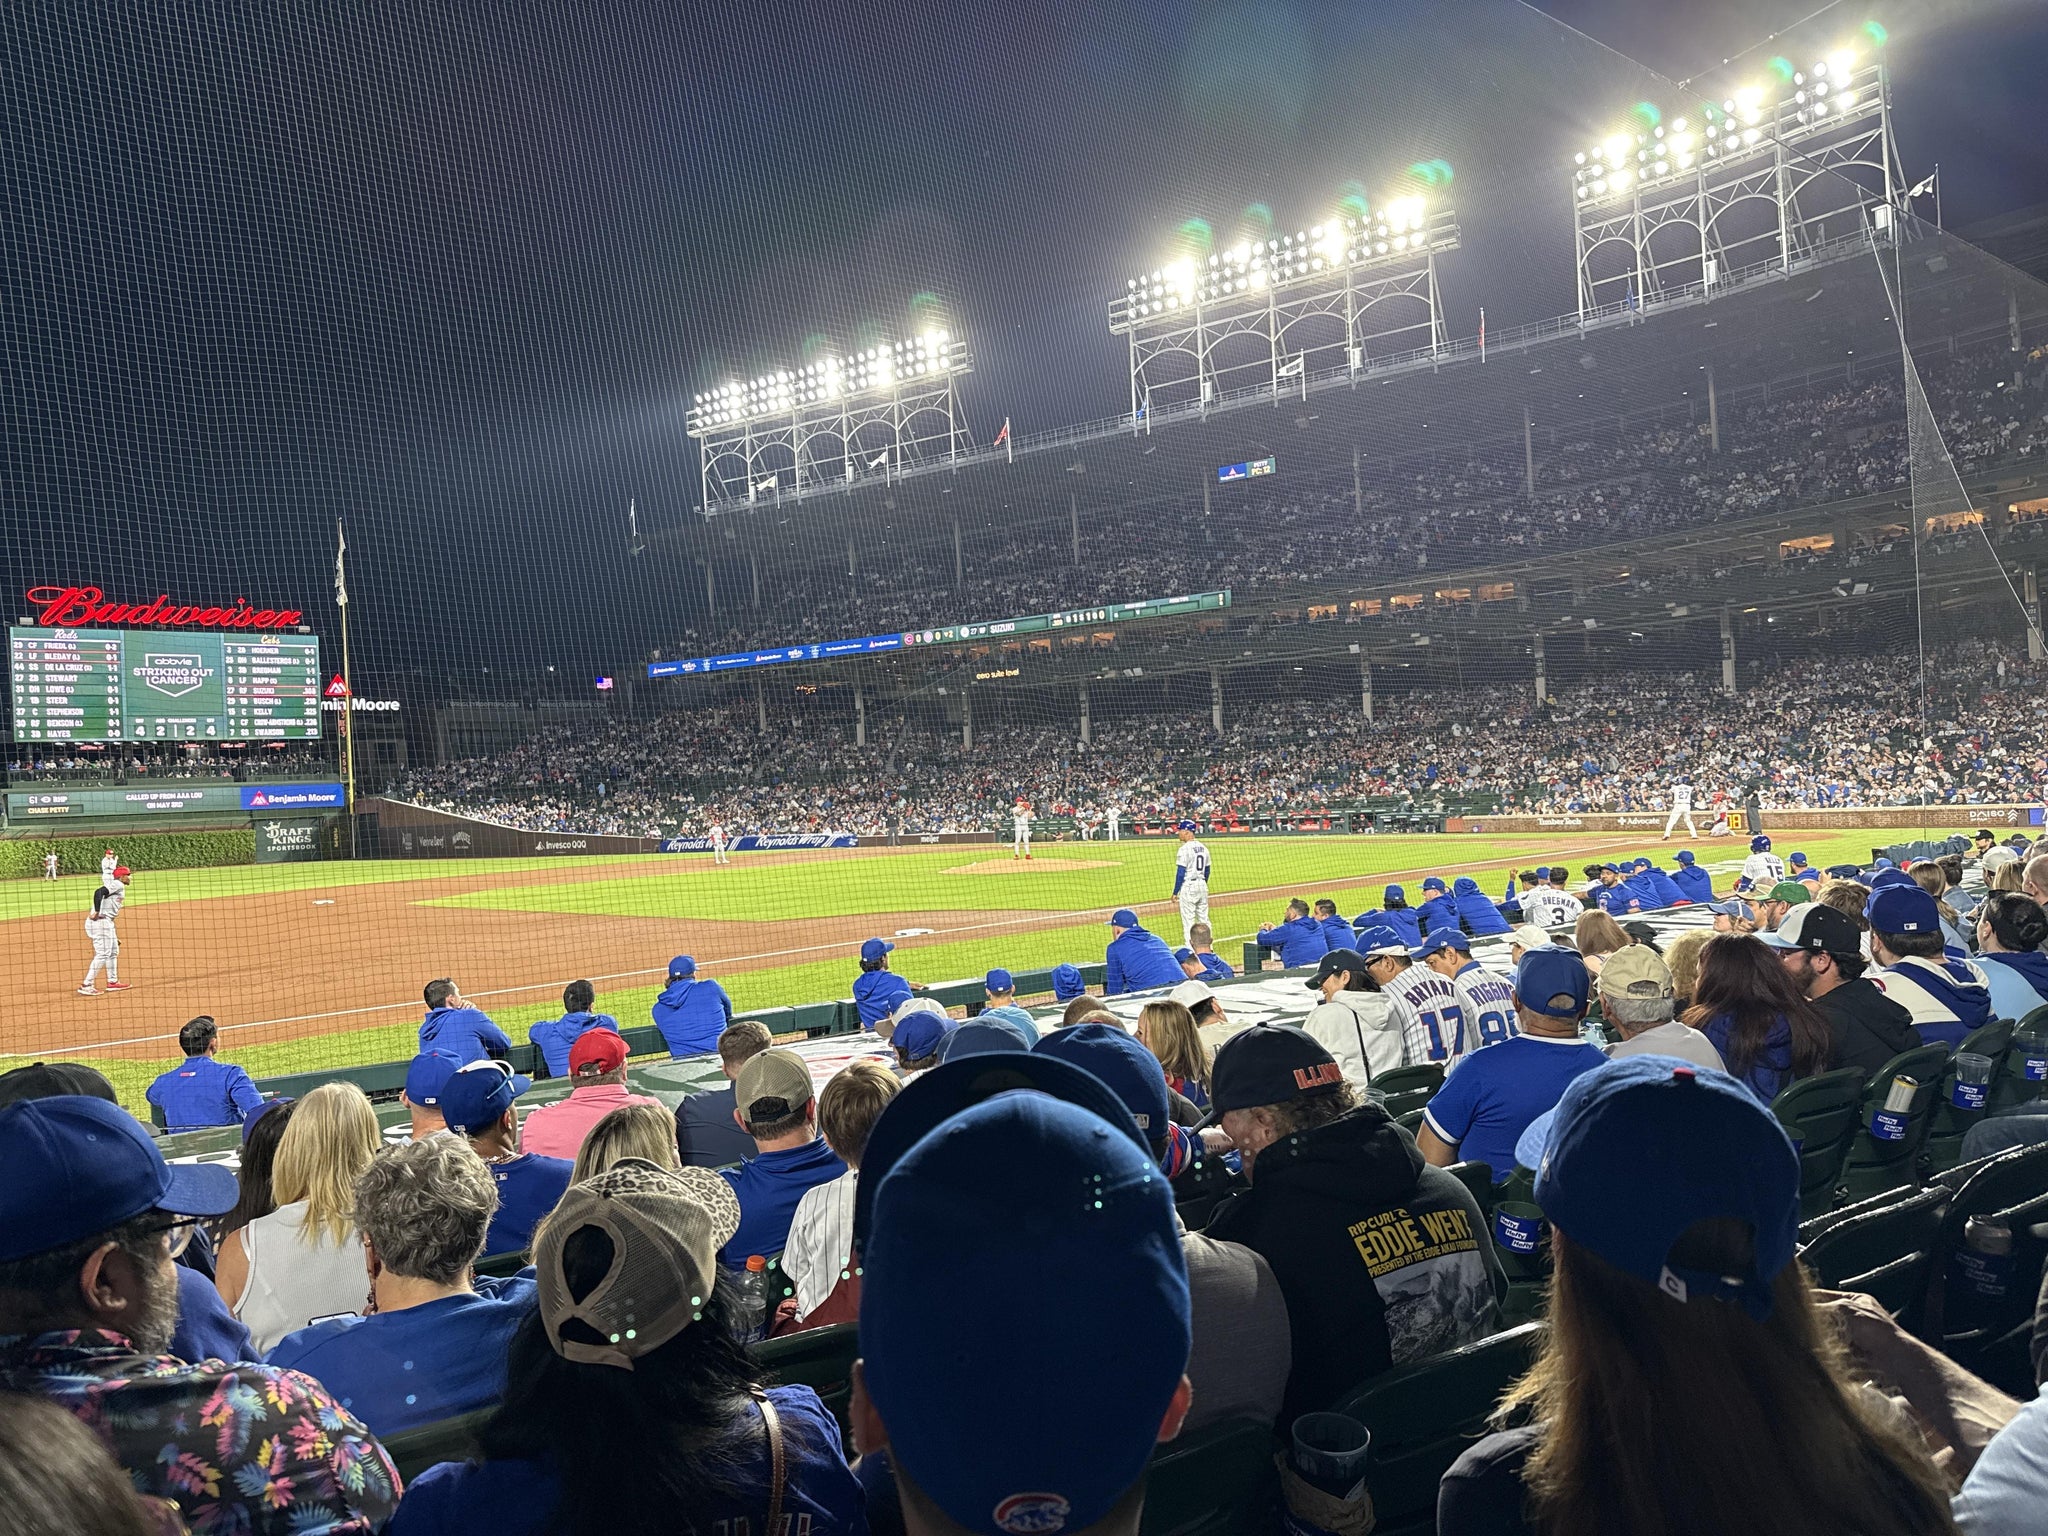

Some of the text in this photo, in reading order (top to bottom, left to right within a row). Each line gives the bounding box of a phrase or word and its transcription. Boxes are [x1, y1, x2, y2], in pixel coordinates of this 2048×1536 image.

[27, 586, 302, 628] Budweiser
[1099, 610, 1104, 619] 0
[55, 629, 78, 639] Reds
[990, 623, 1015, 633] SUZUKI
[133, 668, 214, 676] STRIKING OUT
[320, 698, 400, 710] min Moore
[136, 725, 216, 736] 4 2 2 4
[268, 794, 336, 804] Benjamin Moore
[1678, 791, 1690, 800] 27
[1537, 817, 1582, 826] TimberTech
[266, 827, 312, 839] DRAFT
[272, 836, 312, 844] KINGS
[546, 841, 571, 849] Invesco
[667, 839, 705, 852] Reynolds
[755, 836, 826, 849] Reynolds Wrap
[267, 844, 316, 852] SPORTSBOOK
[1196, 855, 1204, 871] 0
[1767, 865, 1783, 882] 15
[1542, 896, 1575, 909] BREGMAN
[1552, 907, 1565, 925] 3
[1404, 980, 1455, 1008] BRYANT
[1419, 1005, 1464, 1061] 17
[1501, 1216, 1518, 1229] Hefty
[1354, 1209, 1473, 1267] EDDIE WENT
[1506, 1229, 1526, 1239] Hefty
[1368, 1256, 1405, 1278] PRESENTED
[1405, 1254, 1413, 1265] BY
[1413, 1250, 1425, 1262] THE
[1424, 1246, 1441, 1260] EDDIE
